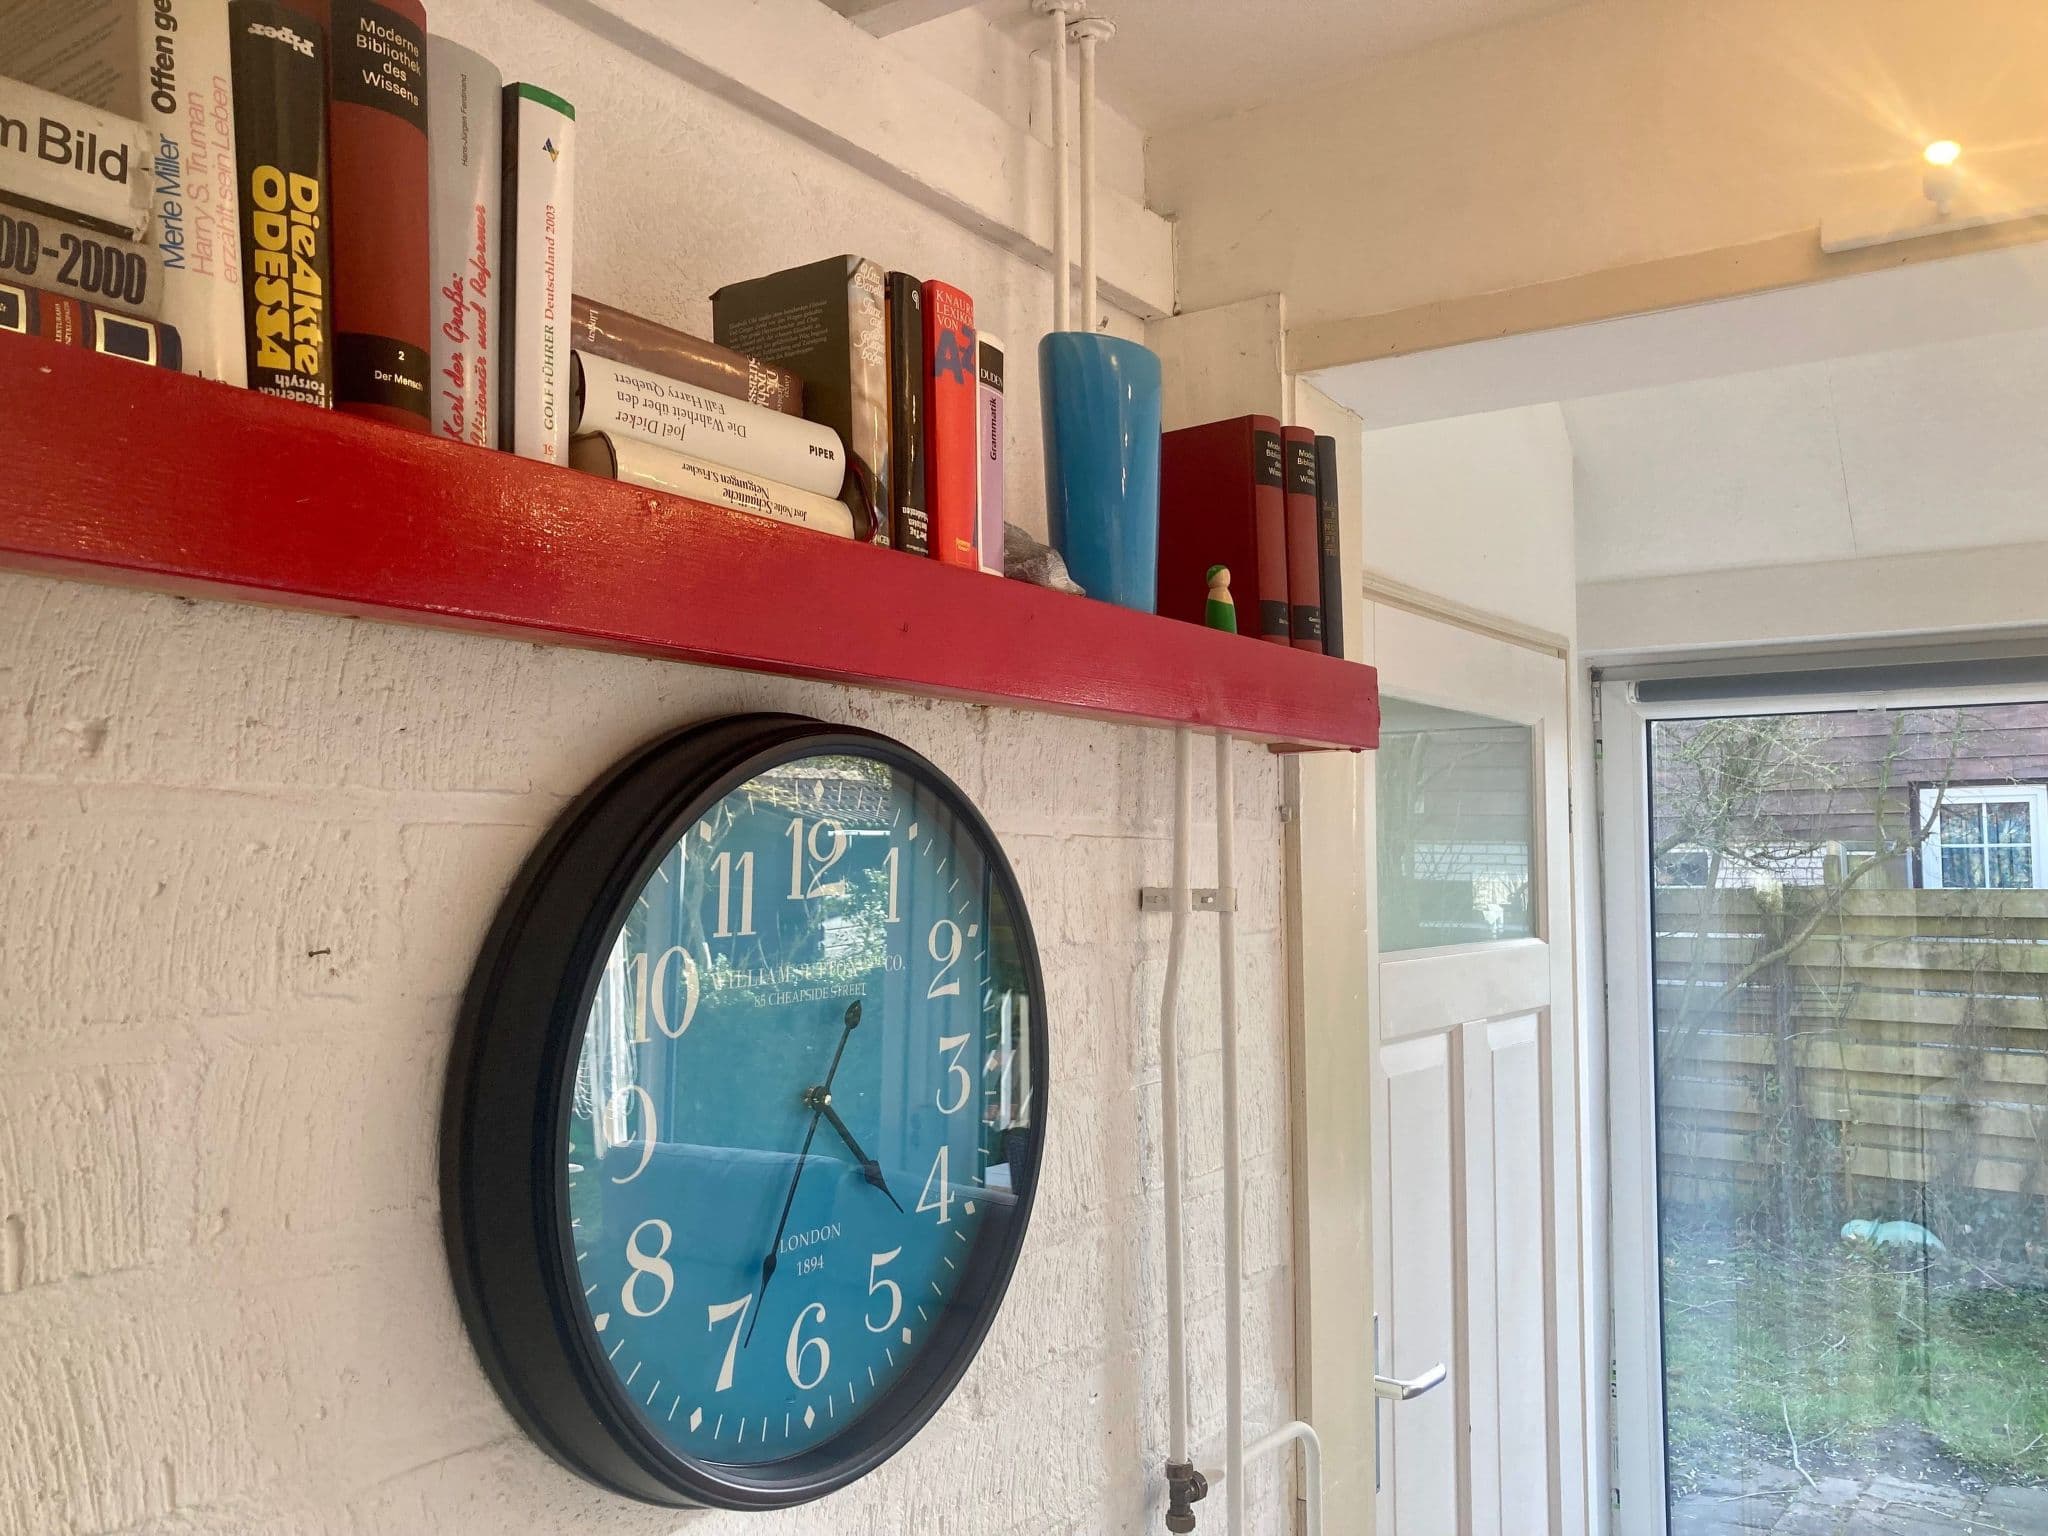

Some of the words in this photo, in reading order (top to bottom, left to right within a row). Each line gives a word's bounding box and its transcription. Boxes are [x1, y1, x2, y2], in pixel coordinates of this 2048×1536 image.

[356, 34, 421, 76] Bibliothek
[360, 17, 419, 57] Moderne
[150, 35, 177, 114] Offen
[362, 69, 419, 106] Wissens
[383, 61, 407, 82] des
[186, 91, 208, 175] Truman
[210, 75, 231, 151] Leben
[38, 116, 128, 185] Bild
[154, 133, 181, 196] Miller
[213, 153, 233, 201] sein
[159, 200, 185, 269] Merle
[191, 206, 215, 276] Harry
[545, 204, 556, 235] 2003
[216, 204, 238, 284] erzählt
[468, 203, 491, 298] Reformer
[252, 165, 291, 371] ODESSA
[543, 237, 556, 321] Deutschland
[442, 273, 470, 344] Große:
[469, 300, 487, 350] und
[937, 314, 960, 331] VON
[398, 350, 405, 361] 2
[442, 352, 464, 389] der
[541, 324, 555, 386] FÜHRER
[274, 374, 325, 396] Forsyth
[374, 370, 391, 382] Der
[394, 373, 424, 392] Mensch
[613, 373, 665, 398] Quebert
[616, 391, 639, 409] den
[667, 386, 702, 408] Harry
[765, 369, 778, 395] Die
[442, 390, 464, 442] Karl
[543, 387, 555, 431] GOLF
[615, 411, 659, 434] Dicker
[642, 398, 670, 416] über
[672, 406, 725, 433] Wahrheit
[704, 399, 725, 415] Fall
[726, 421, 747, 438] Die
[989, 397, 998, 461] Grammatik
[662, 423, 687, 441] Joël
[808, 444, 835, 461] PIPER
[720, 475, 770, 499] Neigungen
[773, 502, 793, 518] Nolte
[793, 508, 808, 522] Jost
[786, 817, 849, 901] 12
[710, 850, 757, 939] 11
[882, 846, 901, 925] 1
[884, 953, 906, 972] CO.
[927, 918, 963, 998] 2
[629, 944, 700, 1045] 10
[768, 986, 829, 1006] CHEAPSIDE
[830, 982, 868, 997] STREET
[935, 1034, 971, 1116] 3
[603, 1083, 658, 1185] 9
[915, 1144, 957, 1225] 4
[780, 1222, 841, 1254] LONDON
[620, 1218, 674, 1318] 8
[796, 1253, 824, 1276] 1894
[863, 1244, 904, 1335] 5
[706, 1292, 752, 1392] 7
[784, 1301, 831, 1391] 6
